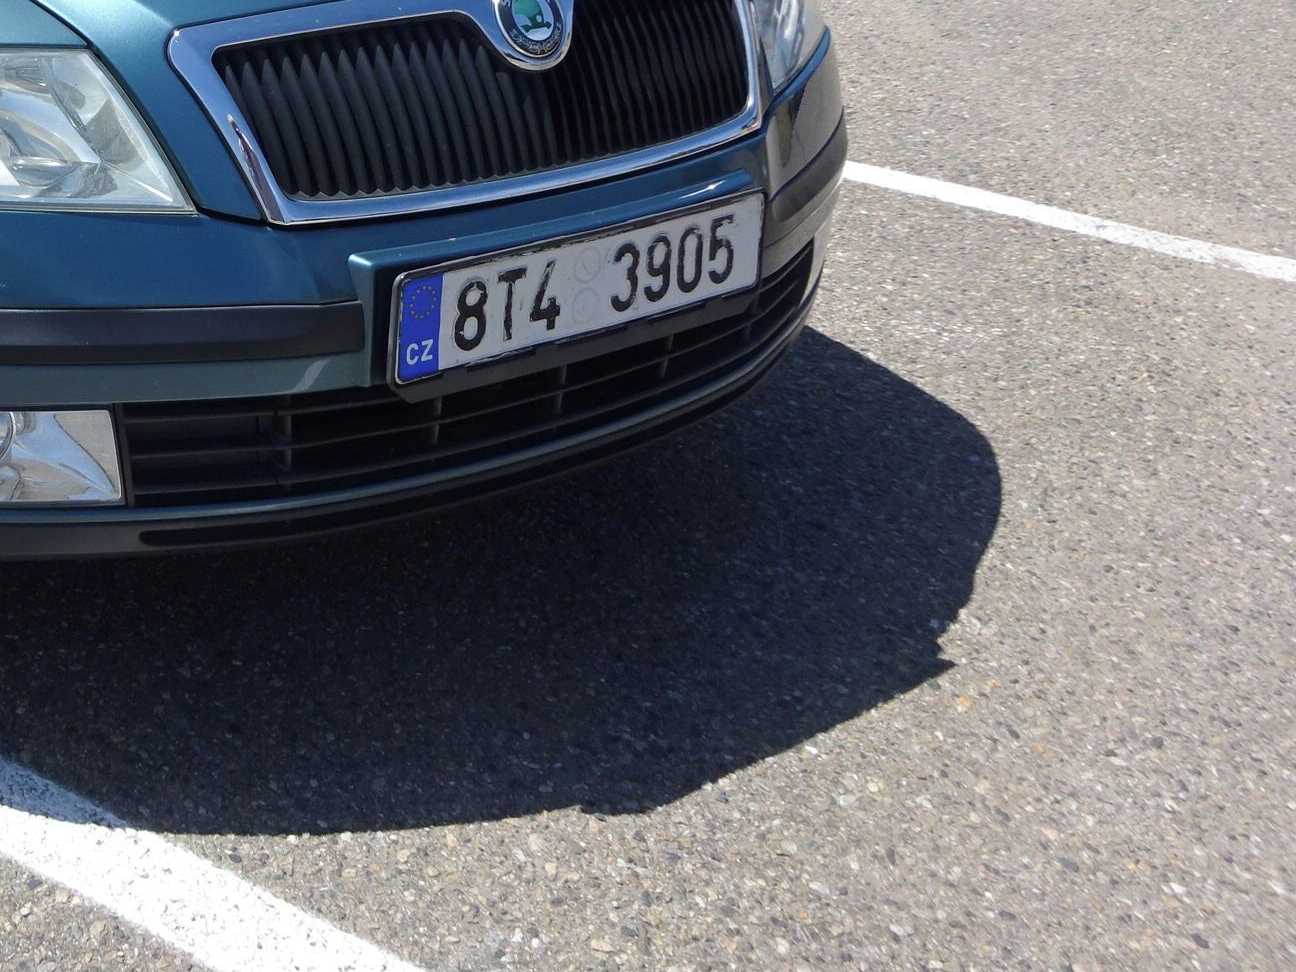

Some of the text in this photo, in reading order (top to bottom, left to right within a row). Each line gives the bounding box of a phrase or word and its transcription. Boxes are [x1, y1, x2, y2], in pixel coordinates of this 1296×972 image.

[453, 212, 736, 352] 8T4 3905
[406, 338, 434, 366] CZ
